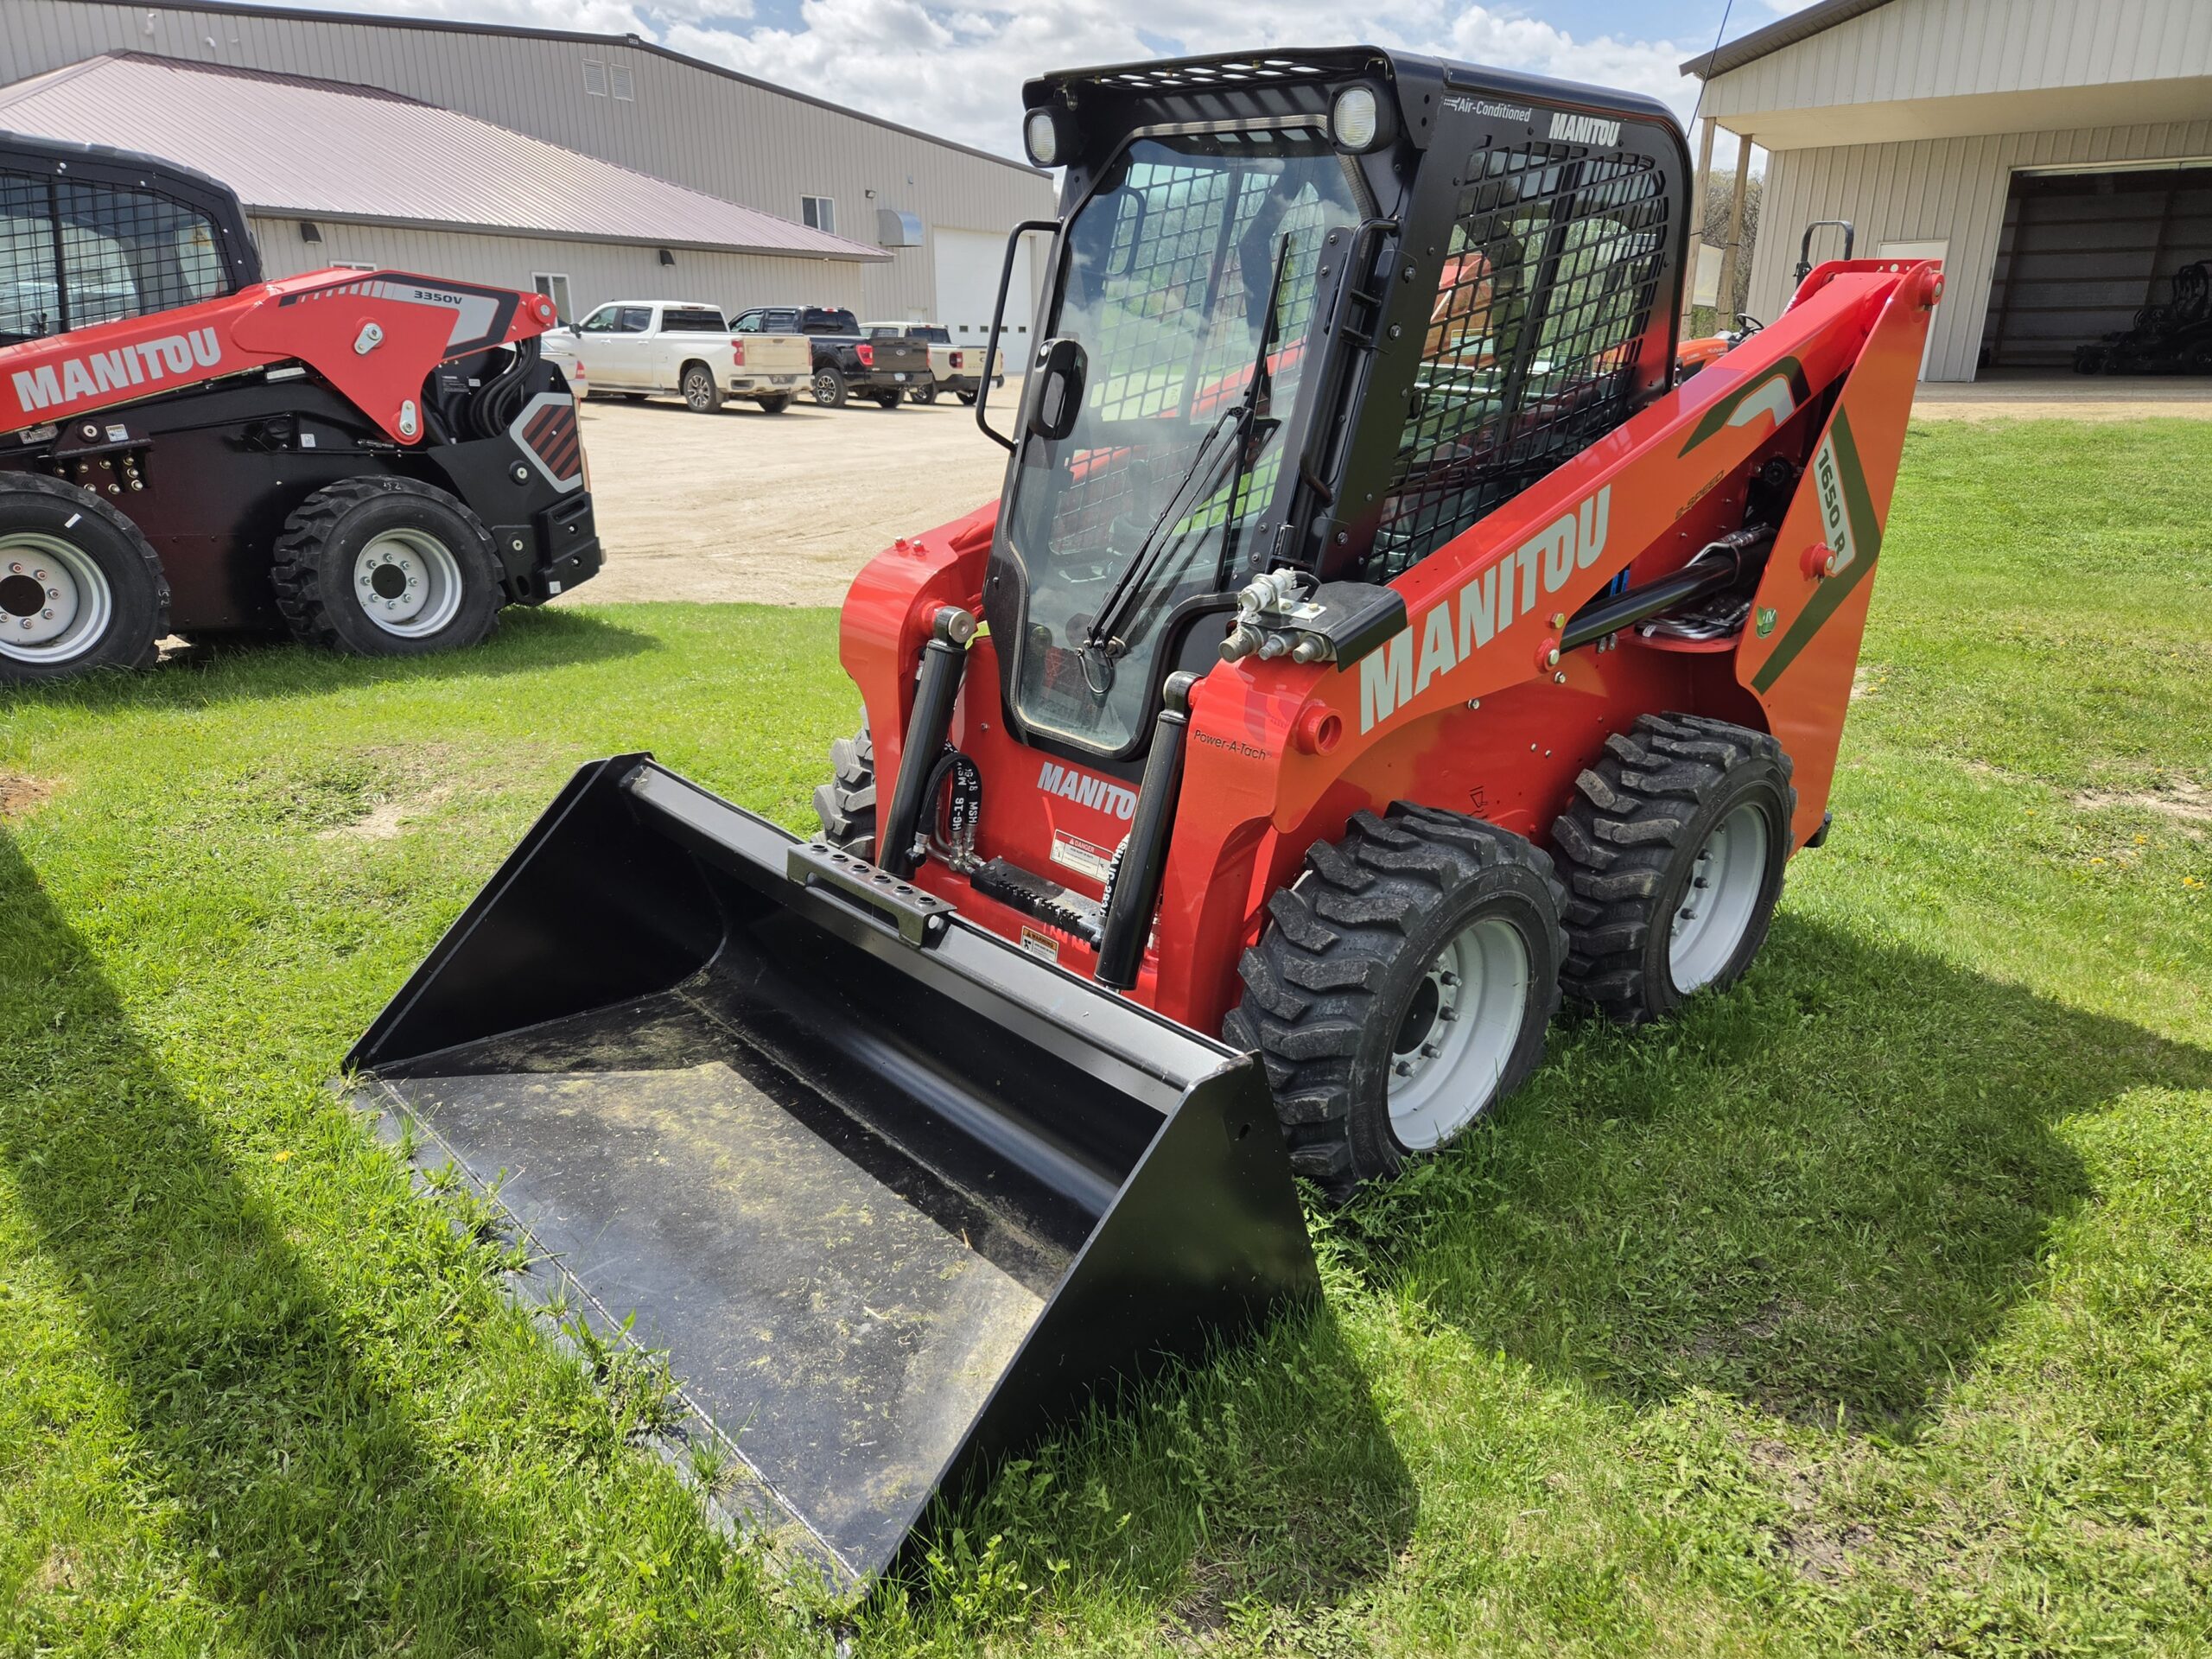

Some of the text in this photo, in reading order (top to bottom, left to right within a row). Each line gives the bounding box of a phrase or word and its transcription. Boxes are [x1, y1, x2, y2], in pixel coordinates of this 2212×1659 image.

[1458, 99, 1532, 123] Air-Conditioned
[1548, 112, 1621, 147] MANITOU
[414, 290, 462, 305] 3350V
[11, 327, 222, 412] MANITOU
[1675, 469, 1725, 520] 2-SPEED
[1818, 448, 1847, 559] 1650 R
[1360, 483, 1611, 735] MANITOU
[1193, 729, 1267, 761] Power-A-Tach
[1037, 761, 1137, 820] MANITO
[952, 797, 964, 831] HG-16
[1074, 840, 1095, 853] DANGER
